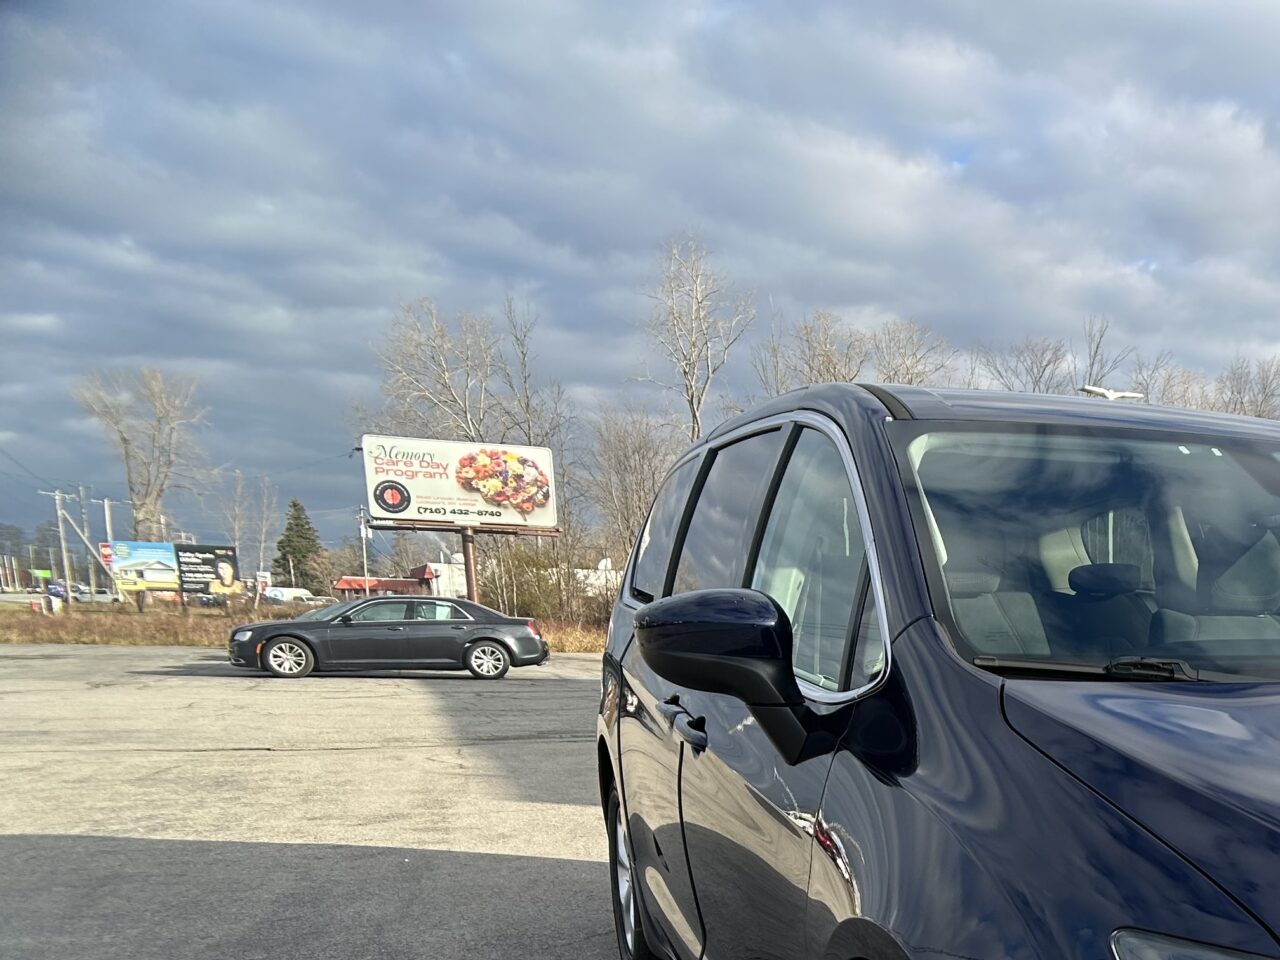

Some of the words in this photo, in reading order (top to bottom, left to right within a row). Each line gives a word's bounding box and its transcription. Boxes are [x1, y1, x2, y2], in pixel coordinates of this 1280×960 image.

[368, 445, 434, 462] Memory
[374, 456, 414, 468] Care
[419, 459, 449, 473] Day
[375, 466, 449, 480] Program
[417, 506, 447, 515] (716)
